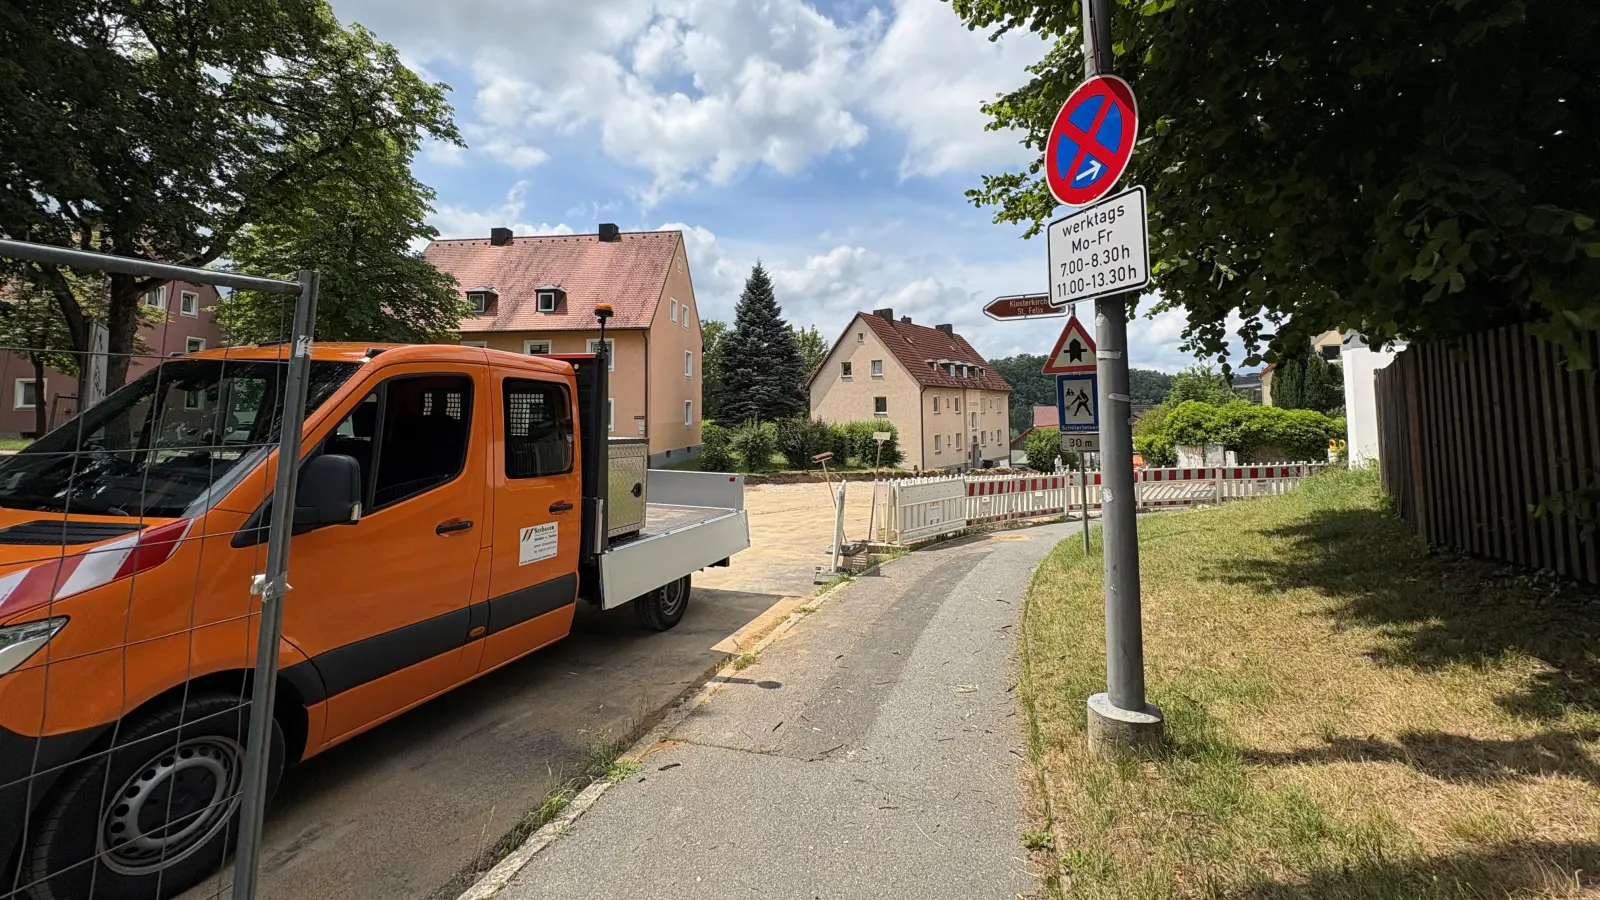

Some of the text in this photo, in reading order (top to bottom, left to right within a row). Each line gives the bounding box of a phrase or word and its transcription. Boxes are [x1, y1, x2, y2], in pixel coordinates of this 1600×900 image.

[1062, 204, 1125, 238] werktags
[1071, 229, 1113, 254] Mo-Fr
[1009, 298, 1048, 308] Klosterkirch
[1028, 306, 1044, 314] Felix
[1069, 438, 1082, 448] 30
